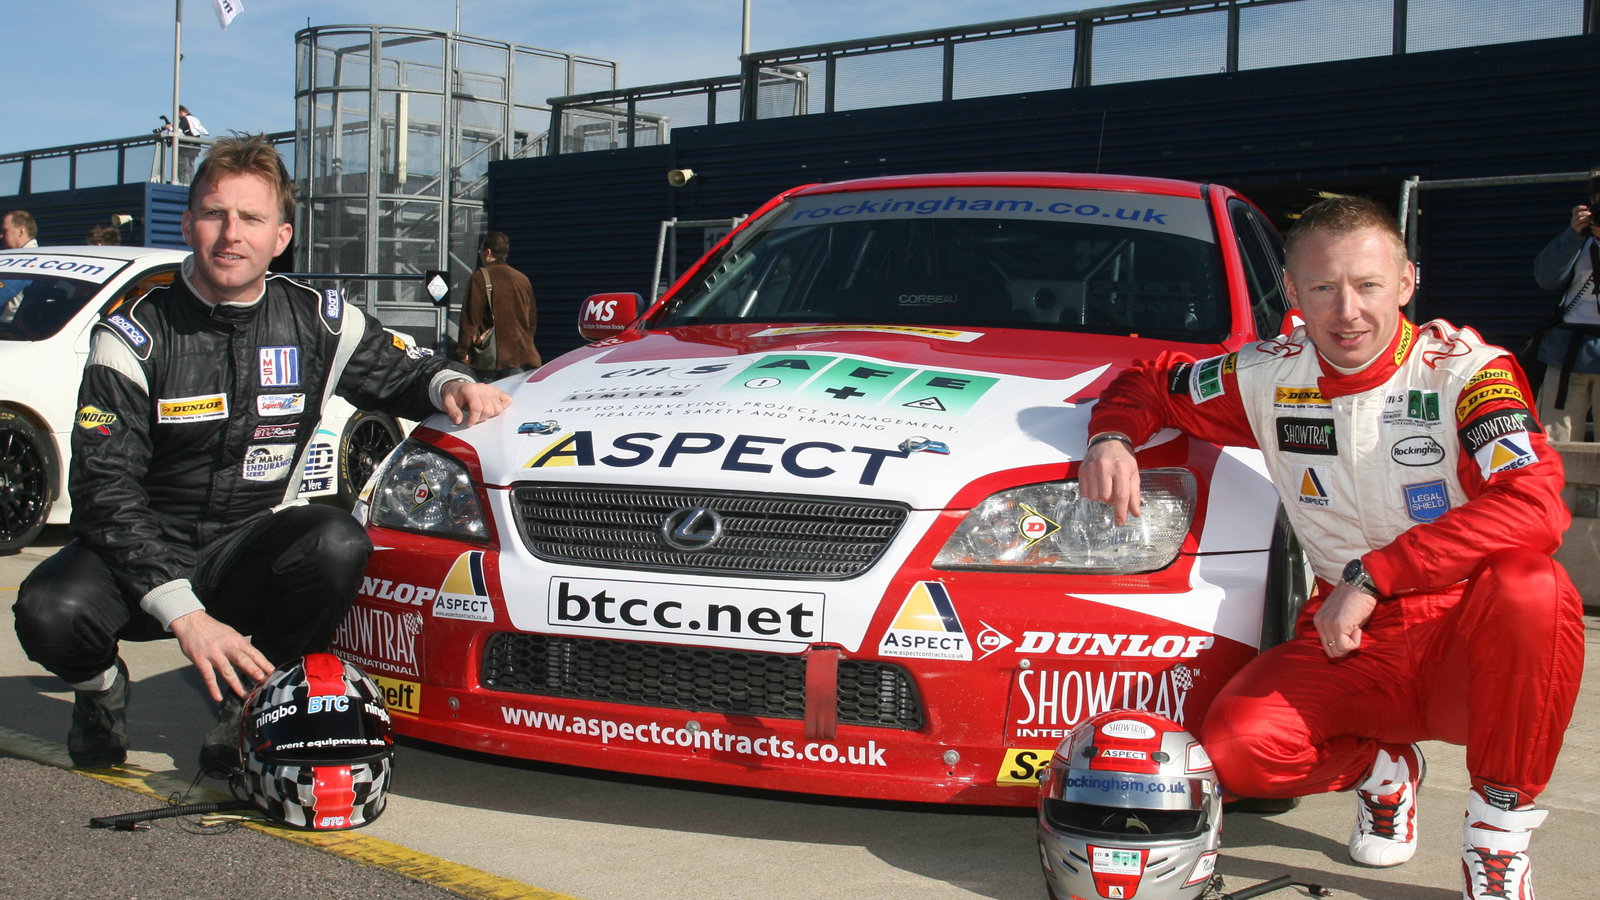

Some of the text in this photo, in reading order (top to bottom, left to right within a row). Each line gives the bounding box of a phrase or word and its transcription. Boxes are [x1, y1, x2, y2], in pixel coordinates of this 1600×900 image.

[792, 196, 1169, 226] rockingham.co.uk
[898, 294, 959, 305] CORBEAU
[584, 300, 618, 321] MS
[111, 315, 145, 343] sparco
[1468, 370, 1510, 386] Sabelt
[569, 391, 684, 401] LIMITED
[1288, 392, 1323, 400] DUNL
[172, 401, 223, 413] DUNLOP
[546, 400, 960, 434] ASBESTOS SURVEYING, PROJECT MANAGEMENT,
[594, 409, 656, 418] HEALTH
[682, 408, 745, 417] SAFETY
[750, 410, 788, 420] AND
[797, 415, 887, 432] TRAINING
[1284, 424, 1330, 448] SHOWTRAX
[1467, 415, 1526, 450] SHOWTRAX
[260, 454, 284, 463] MANS
[530, 431, 911, 487] ASPECT
[1394, 445, 1442, 456] Rockingham
[308, 480, 321, 491] Vere
[1299, 496, 1330, 506] ASPECT
[1411, 493, 1443, 503] LEGAL
[1412, 500, 1446, 511] SHIELD
[436, 596, 488, 613] ASPECT
[557, 582, 815, 638] btcc.net
[884, 632, 964, 651] ASPECT
[1015, 630, 1215, 658] DUNLOP
[332, 649, 416, 676] INTERNATIONAL
[883, 649, 964, 659] www.aspectcontracts.co.uk
[307, 695, 349, 714] BTC
[1016, 666, 1190, 727] SHOWTRAX
[256, 704, 298, 729] ningbo
[501, 705, 888, 767] www.aspectcontracts.co.uk
[1109, 722, 1148, 736] SHOWTRAX
[276, 741, 305, 751] event
[306, 737, 368, 748] equipment
[1102, 749, 1147, 760] ASPECT
[320, 816, 345, 827] BTC
